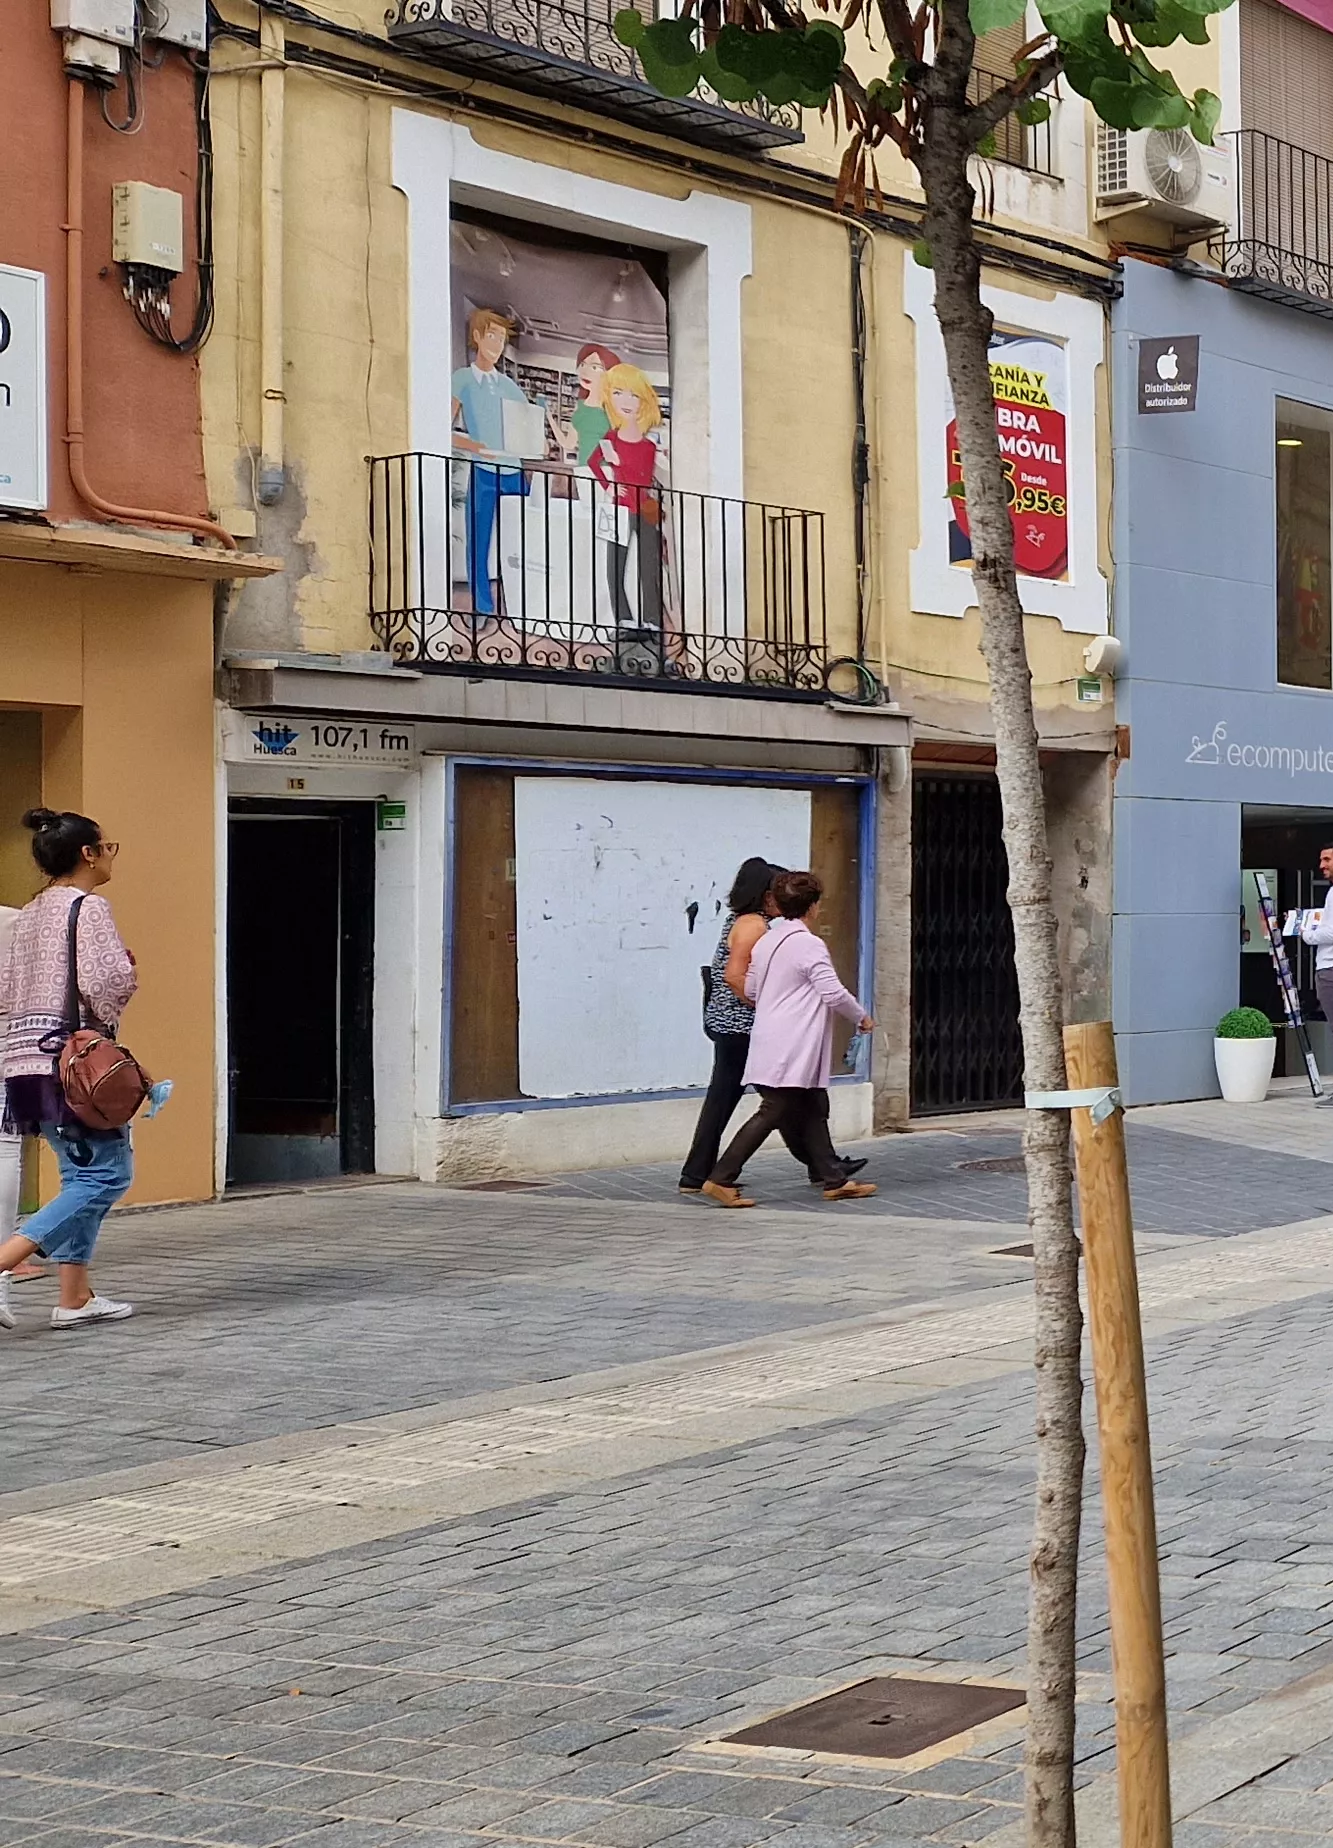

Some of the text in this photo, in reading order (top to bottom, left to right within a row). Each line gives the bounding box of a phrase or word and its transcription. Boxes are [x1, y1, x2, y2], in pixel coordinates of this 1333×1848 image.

[1034, 374, 1043, 387] Y
[1144, 382, 1192, 393] Distribuidor
[1145, 396, 1188, 407] autorizado
[1020, 471, 1047, 486] Desde
[258, 721, 409, 752] hit 107,1 fm
[253, 743, 297, 756] Huesca
[289, 778, 305, 790] 15
